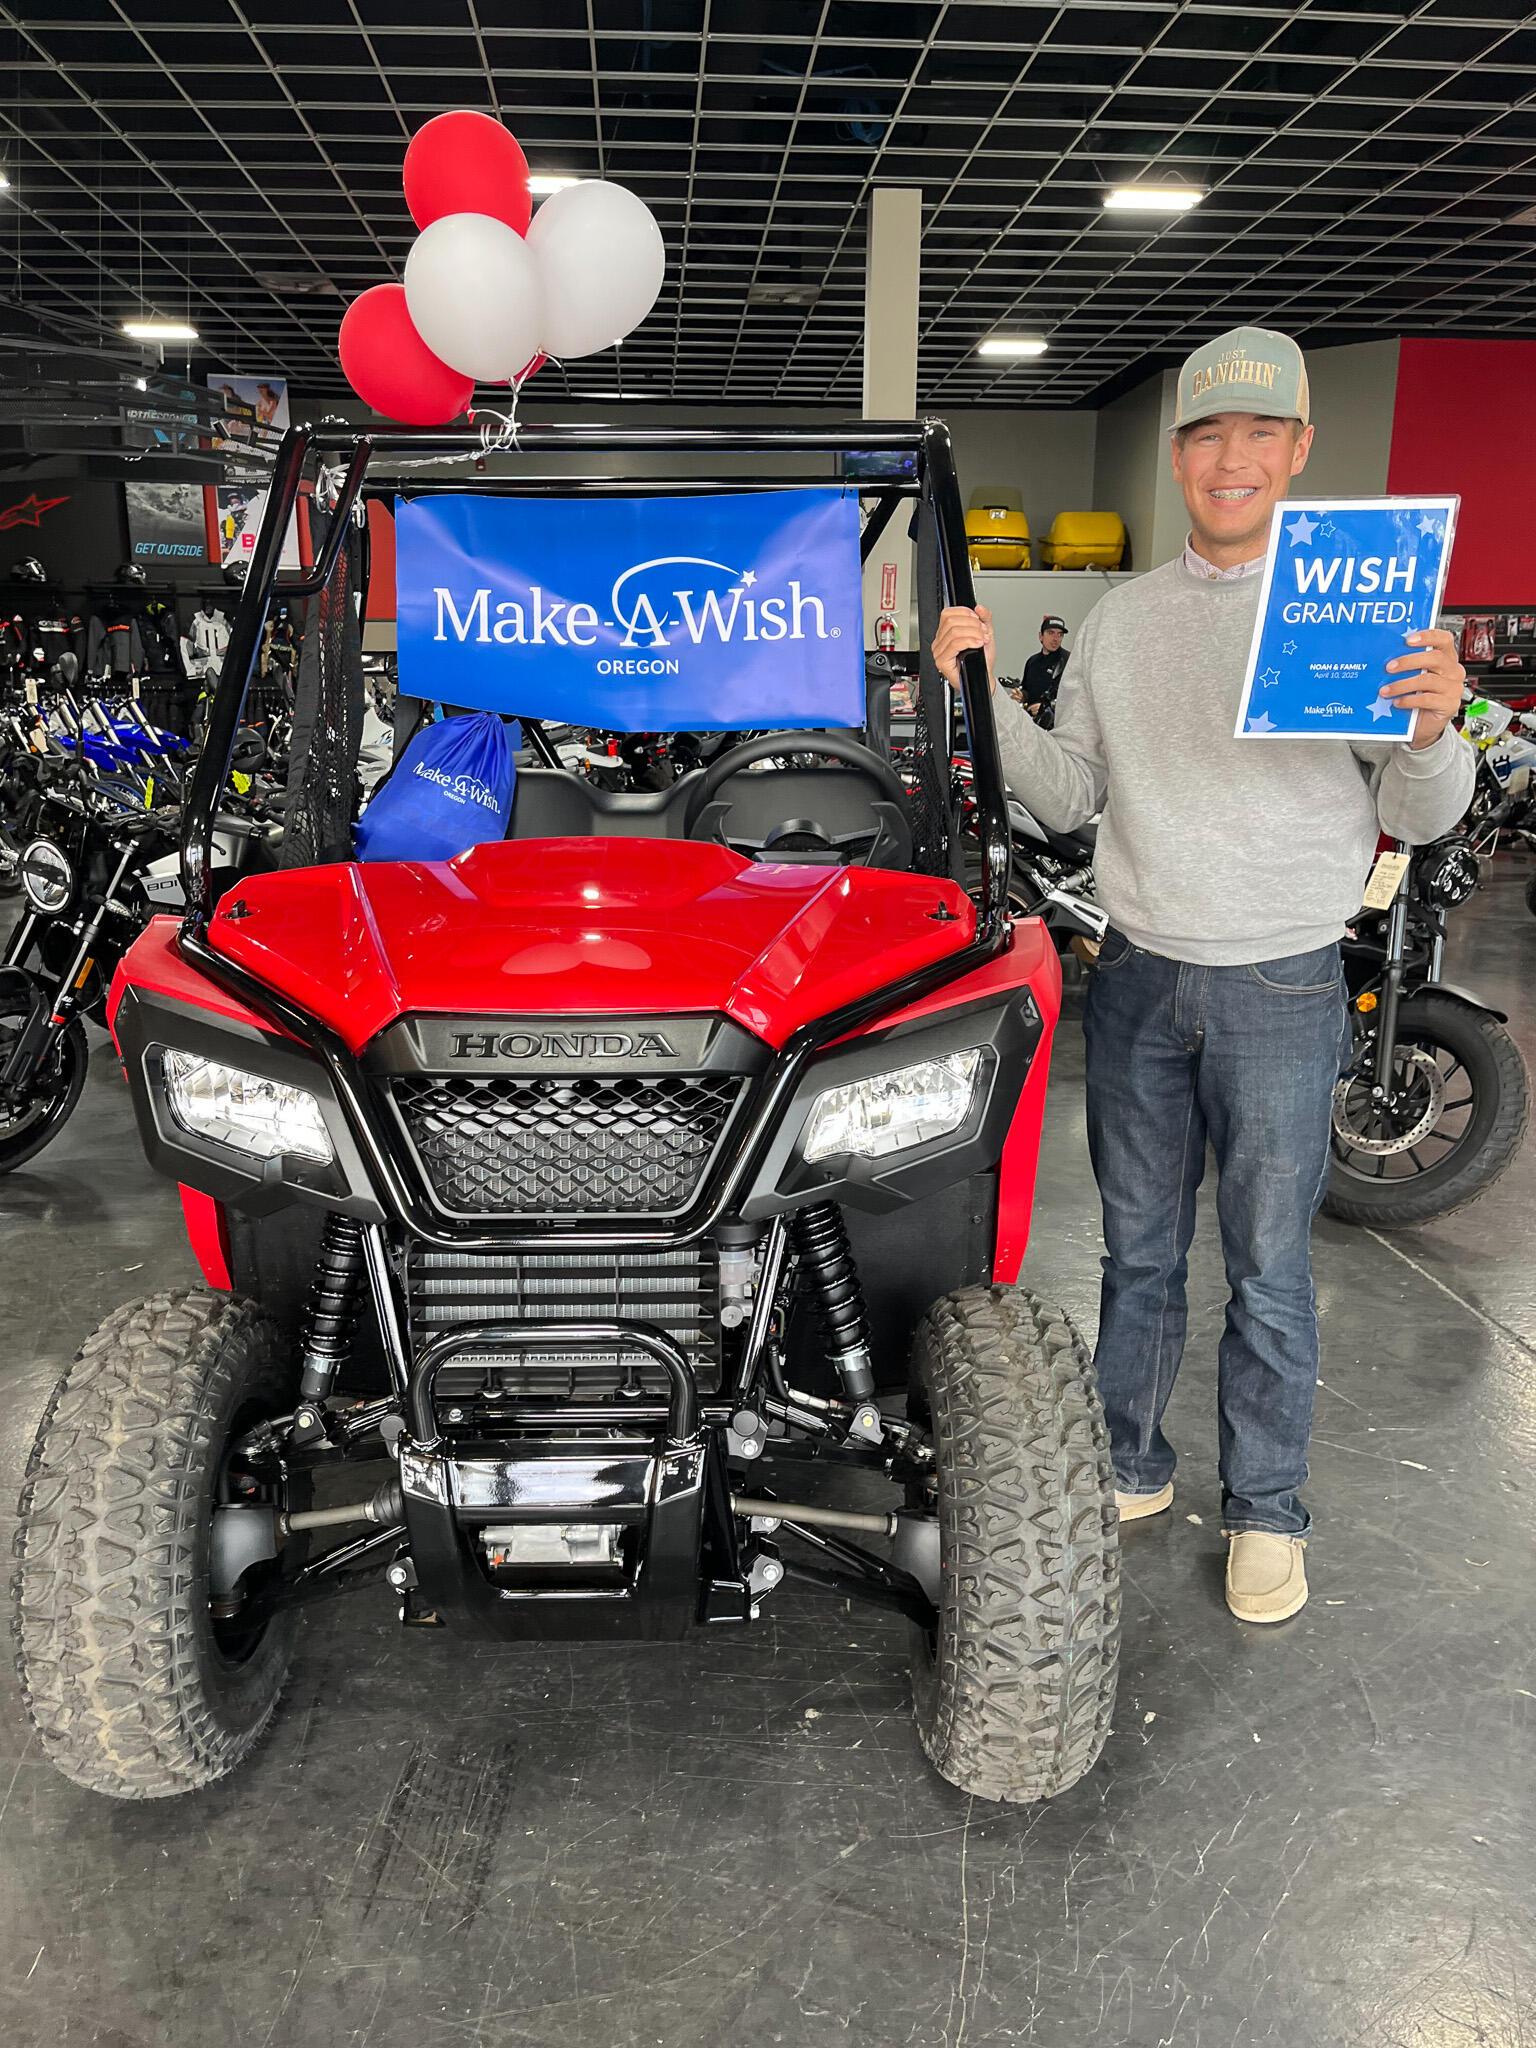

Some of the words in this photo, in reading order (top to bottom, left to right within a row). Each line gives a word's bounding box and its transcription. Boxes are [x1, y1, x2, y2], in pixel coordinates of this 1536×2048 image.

[1218, 349, 1246, 362] JUST
[135, 542, 157, 554] GET
[157, 543, 204, 557] OUTSIDE
[1294, 556, 1417, 594] WISH
[1282, 601, 1414, 624] GRANTED!
[596, 659, 679, 675] OREGON
[1310, 663, 1333, 671] NOAH
[1333, 663, 1339, 671] &
[1340, 663, 1368, 671] FAMILY
[1314, 671, 1330, 679] April
[1342, 671, 1359, 679] 2025
[443, 790, 467, 805] OREGON
[147, 880, 178, 891] 801
[450, 1032, 681, 1058] HONDA
